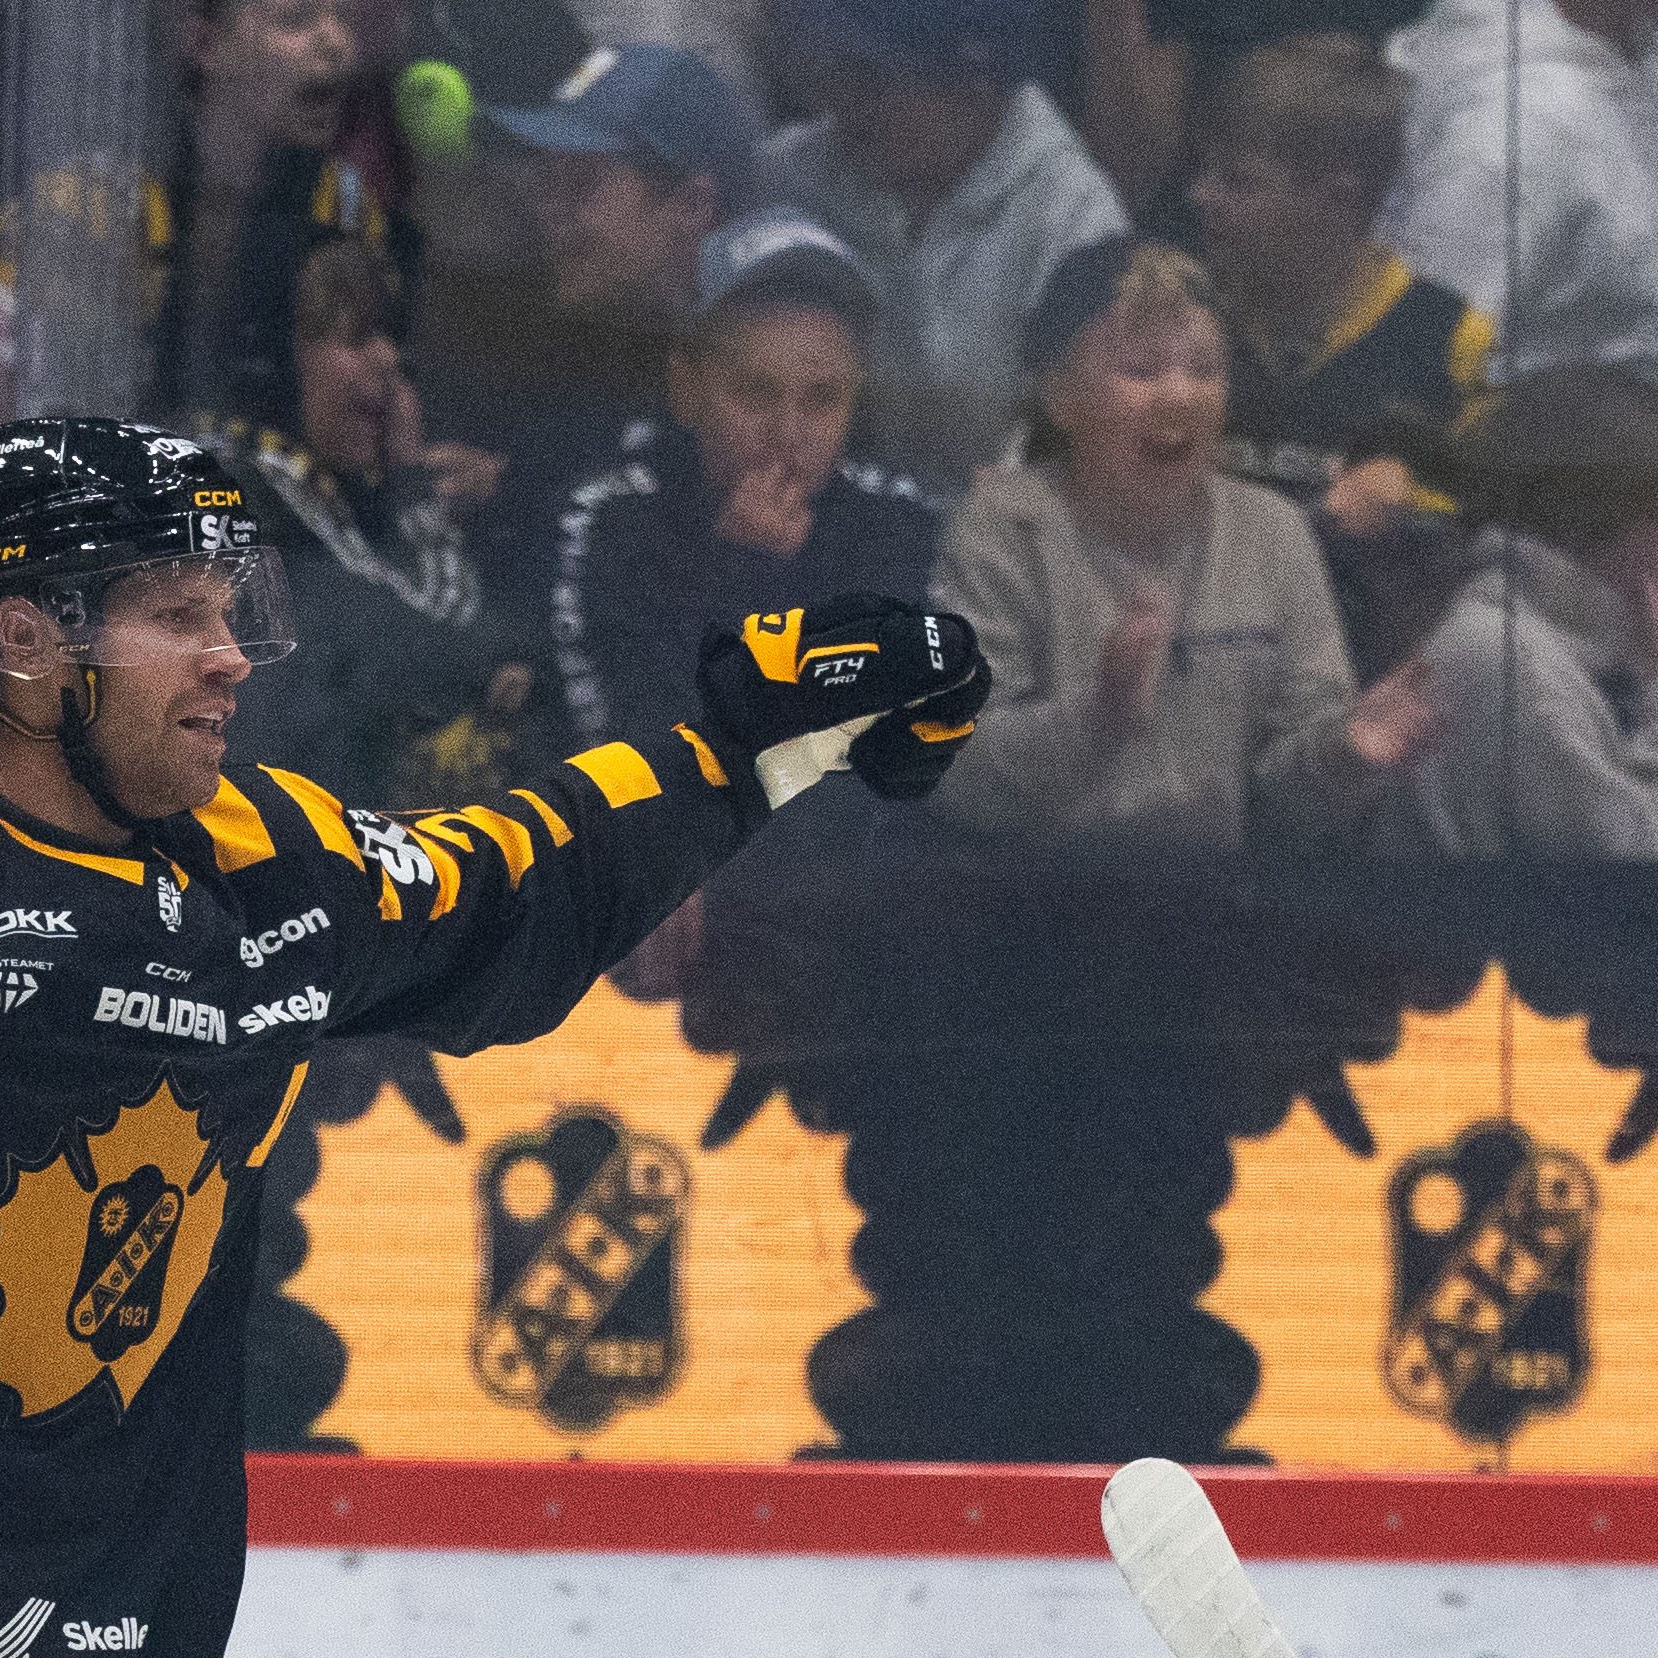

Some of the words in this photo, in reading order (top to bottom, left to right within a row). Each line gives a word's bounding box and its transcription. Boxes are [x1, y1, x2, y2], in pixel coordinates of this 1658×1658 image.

[194, 489, 242, 507] CCM
[924, 616, 944, 671] CCM
[814, 656, 866, 678] FT4
[240, 907, 331, 968] gcon
[144, 962, 193, 983] CCM
[93, 987, 227, 1044] BOLIDEN
[238, 985, 332, 1035] skeb
[118, 1305, 150, 1327] 1921
